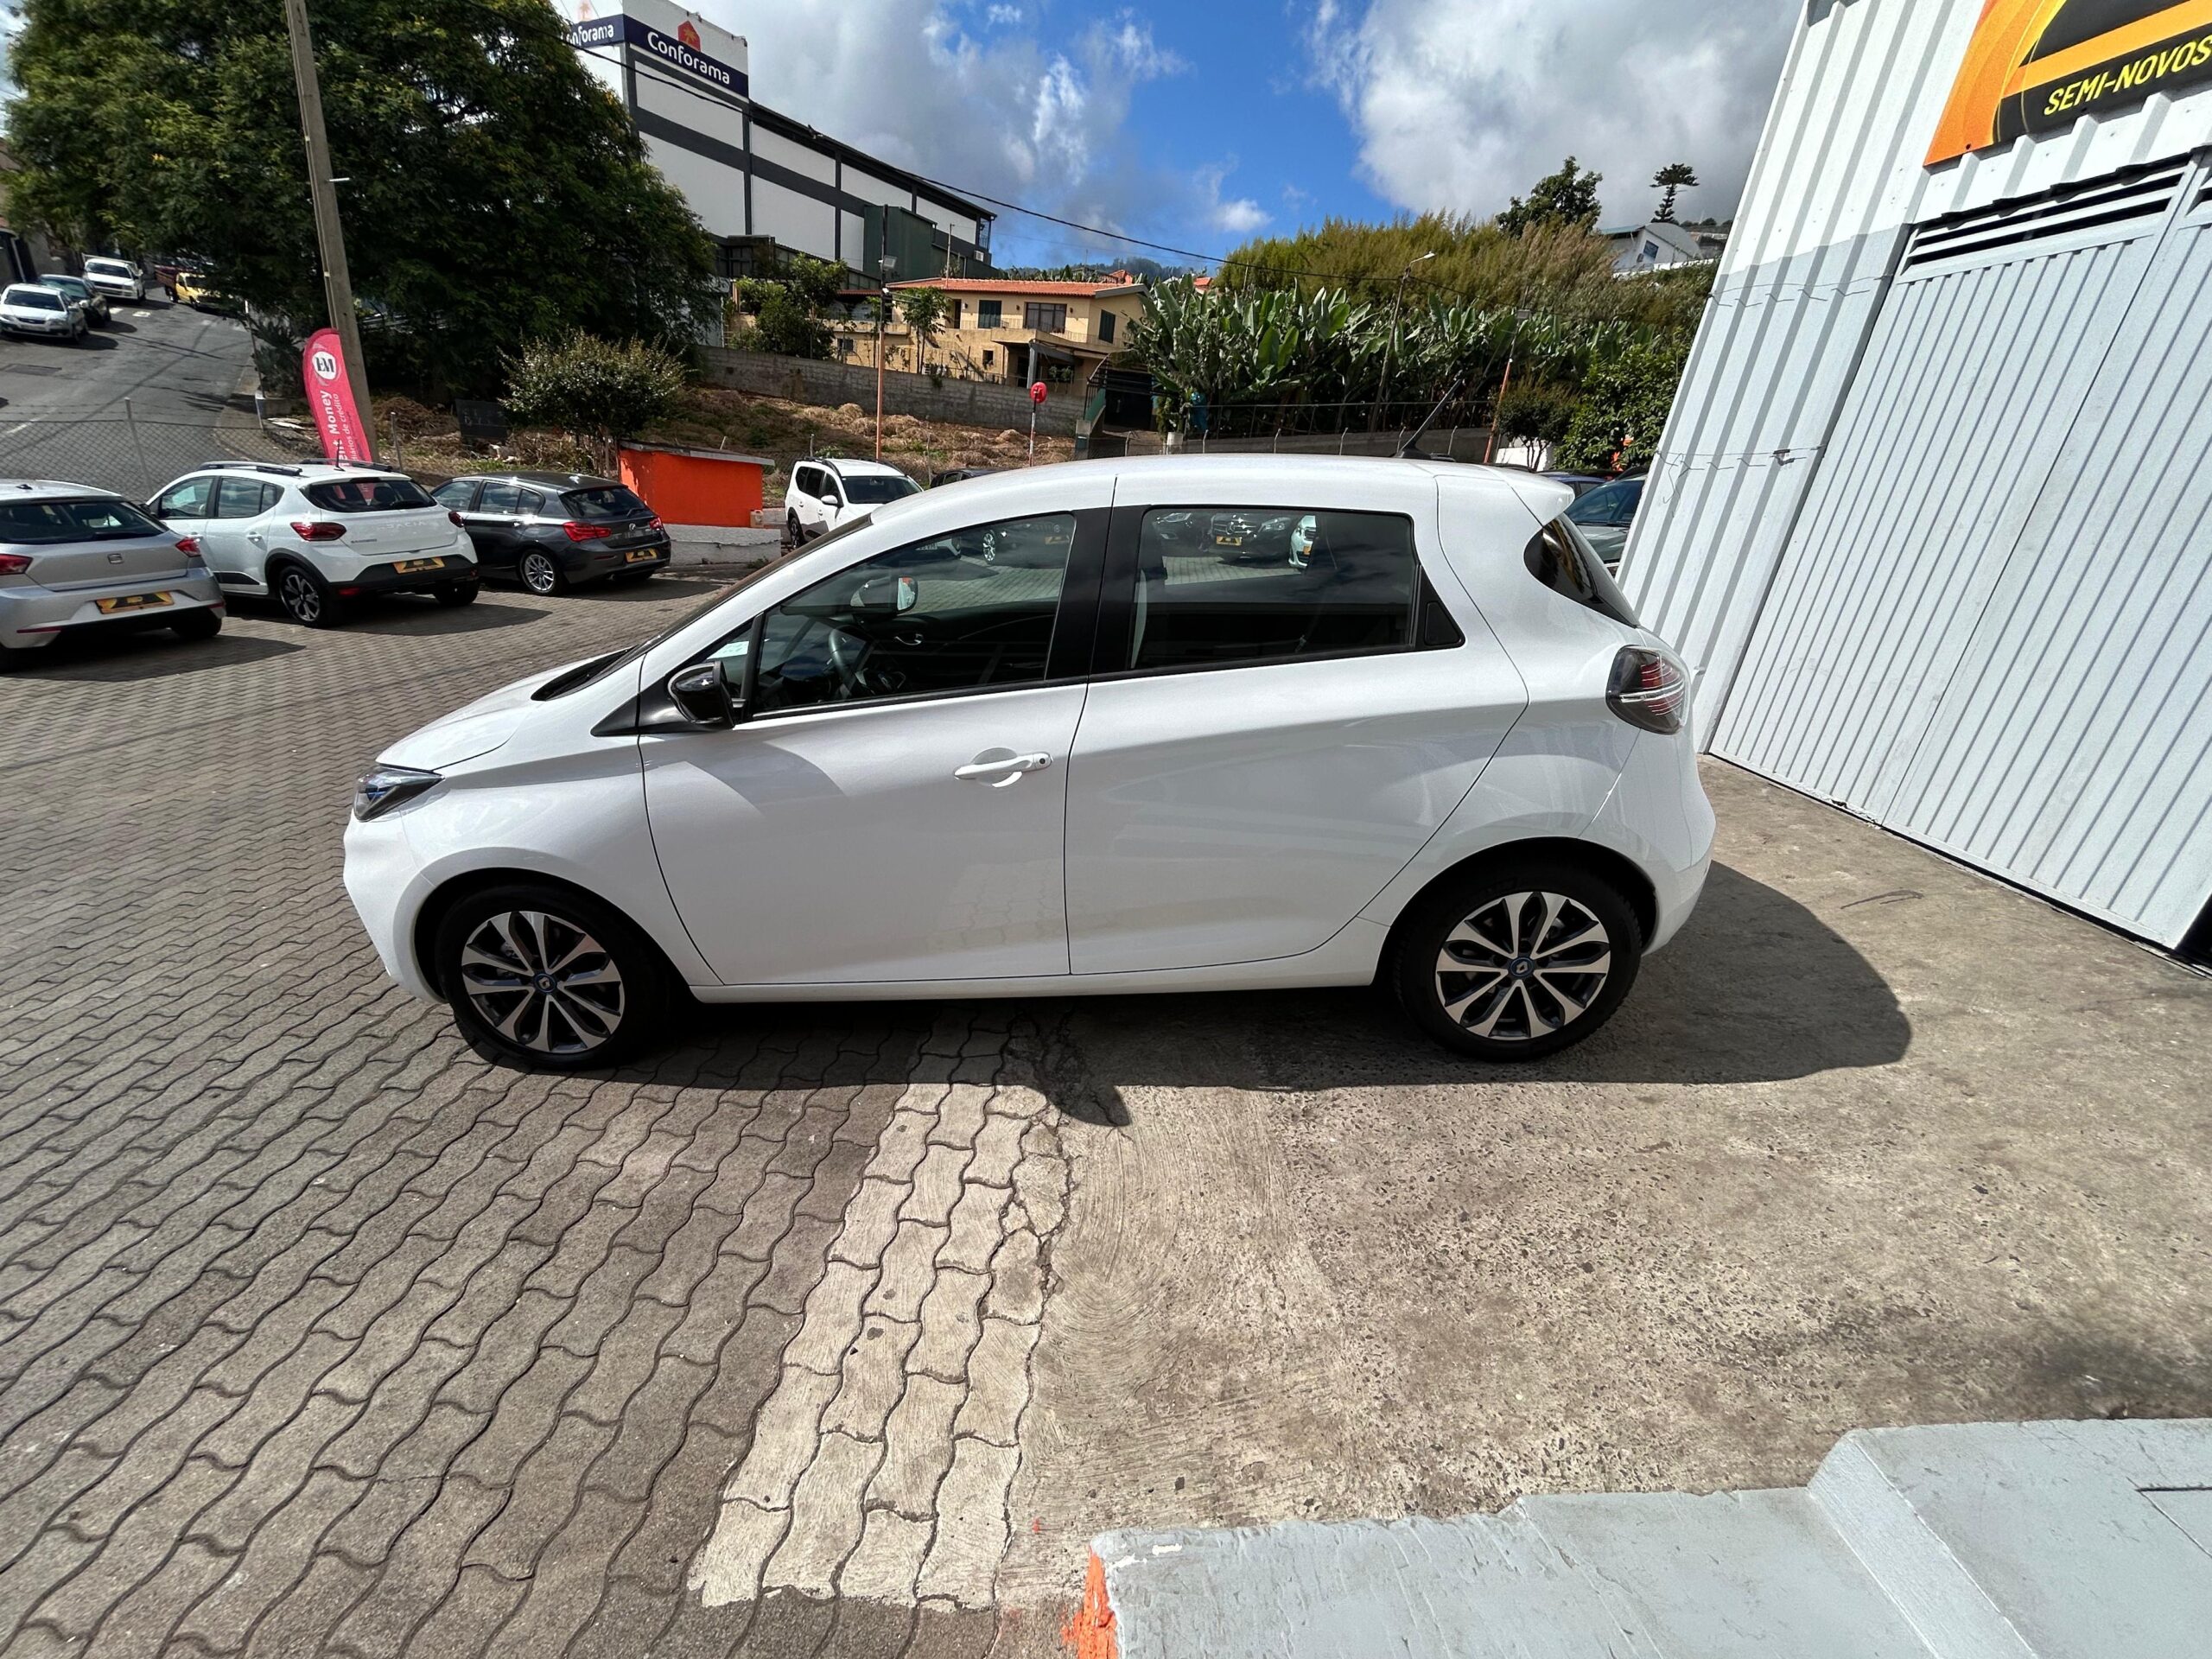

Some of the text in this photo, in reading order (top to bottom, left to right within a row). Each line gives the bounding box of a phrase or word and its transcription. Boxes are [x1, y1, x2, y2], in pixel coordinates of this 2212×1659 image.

[647, 31, 730, 85] Conforama
[2044, 35, 2212, 116] SEMI-NOVOS
[320, 390, 340, 435] Money
